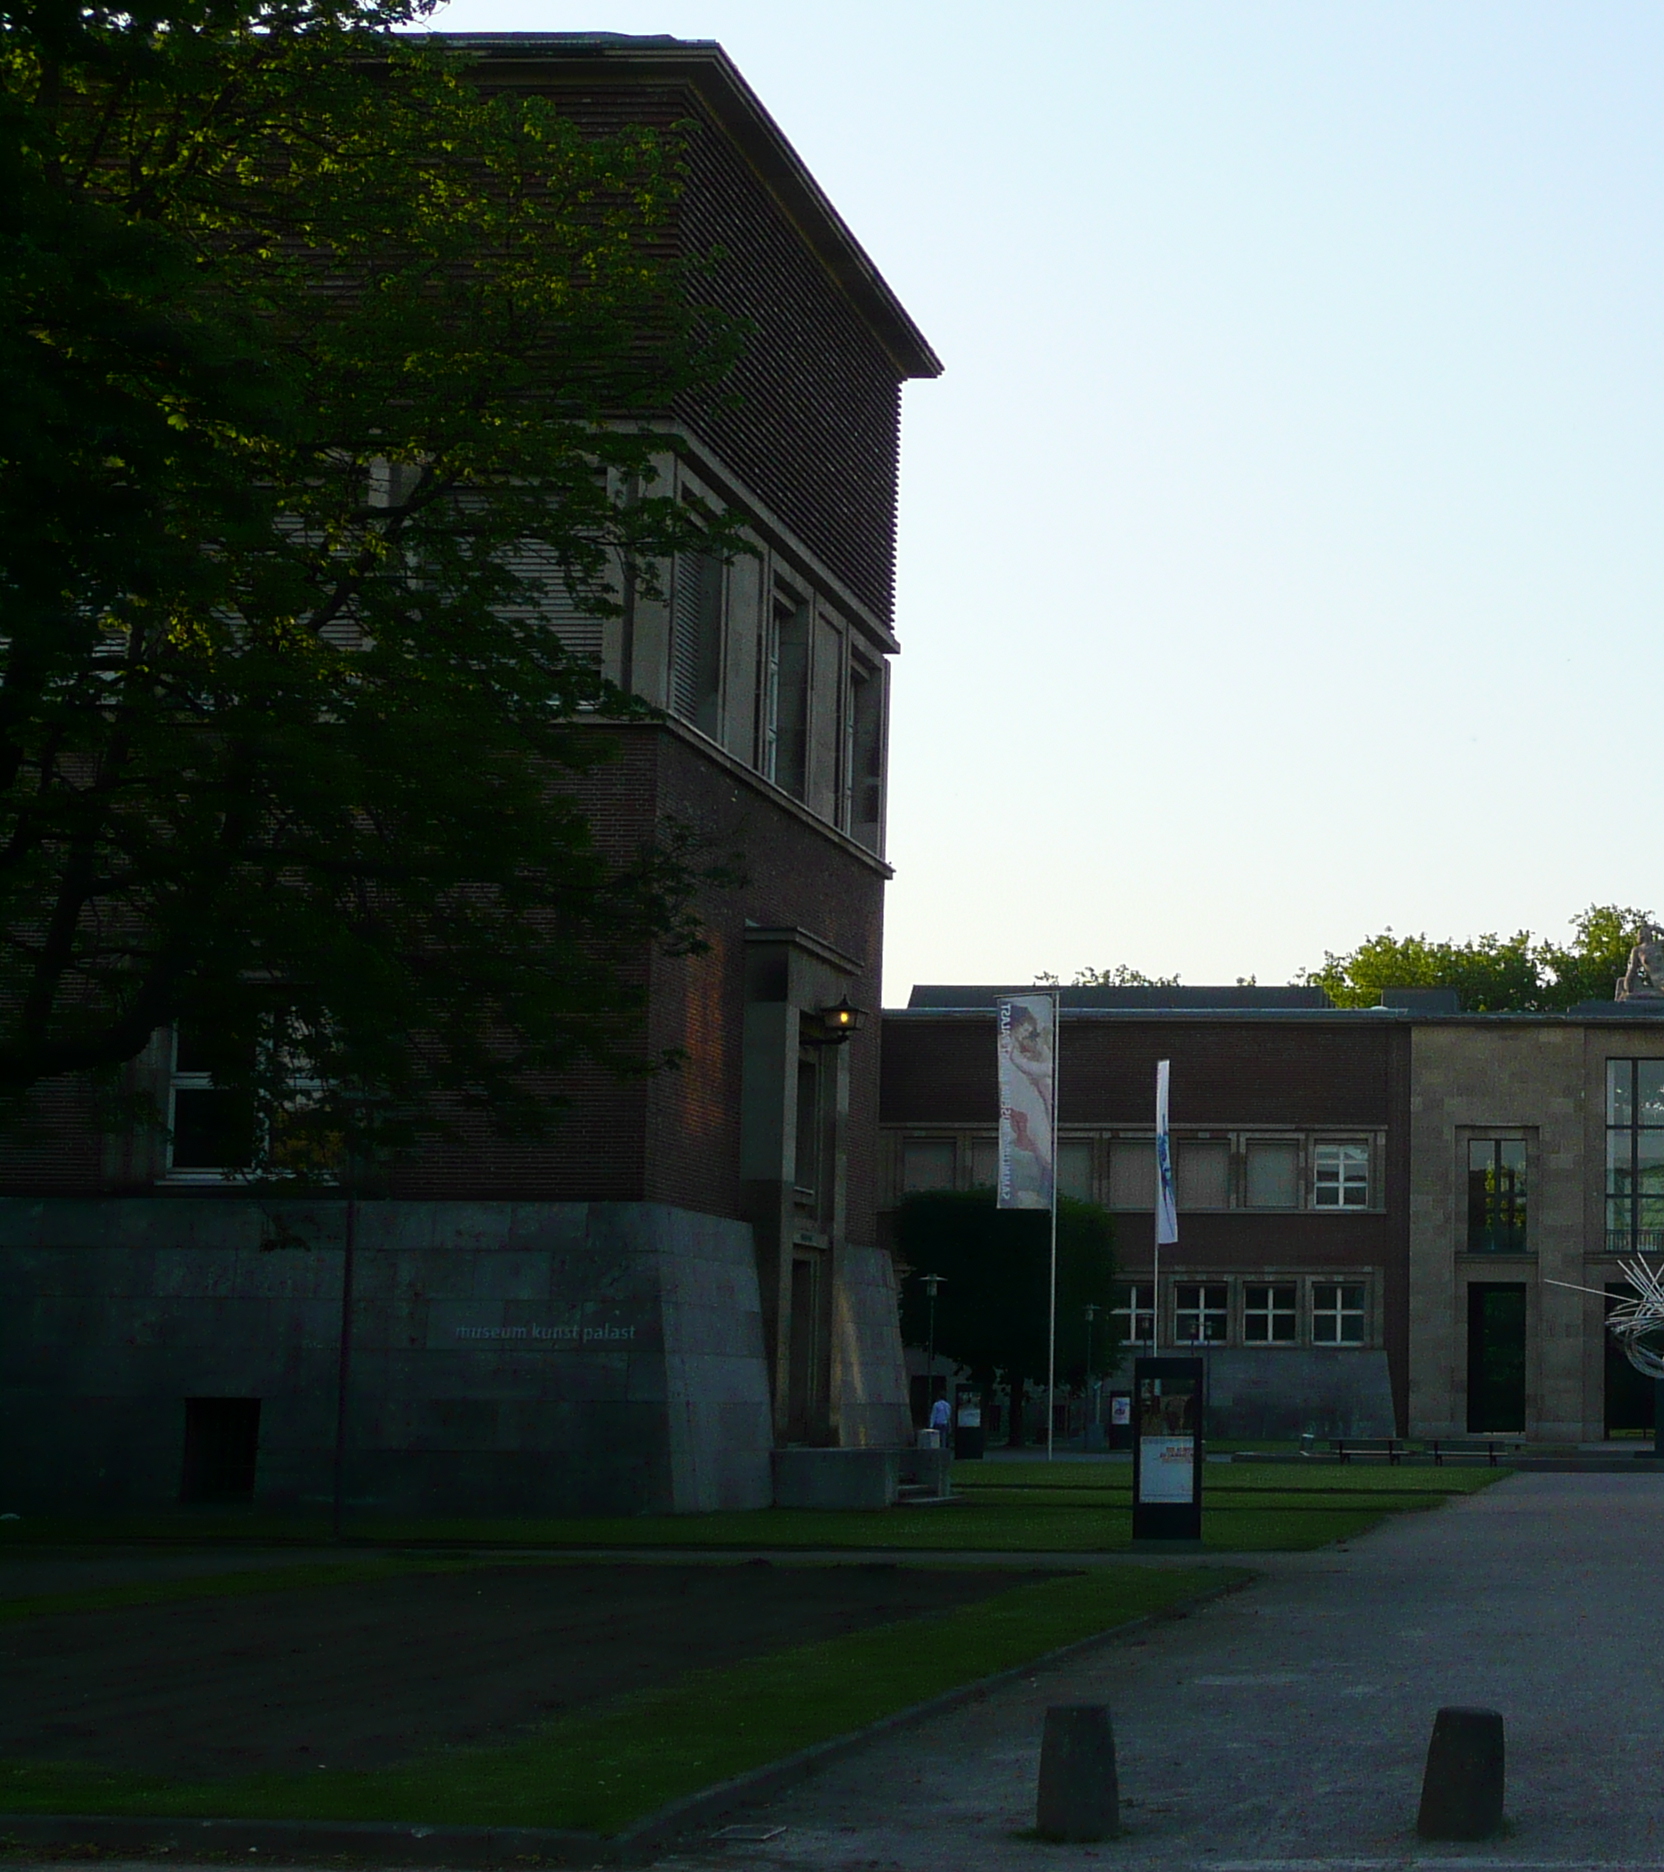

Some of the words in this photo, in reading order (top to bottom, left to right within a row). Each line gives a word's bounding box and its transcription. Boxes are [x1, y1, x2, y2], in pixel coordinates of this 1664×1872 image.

[455, 1325, 527, 1339] museum
[532, 1323, 579, 1339] kunst
[583, 1323, 636, 1343] palast
